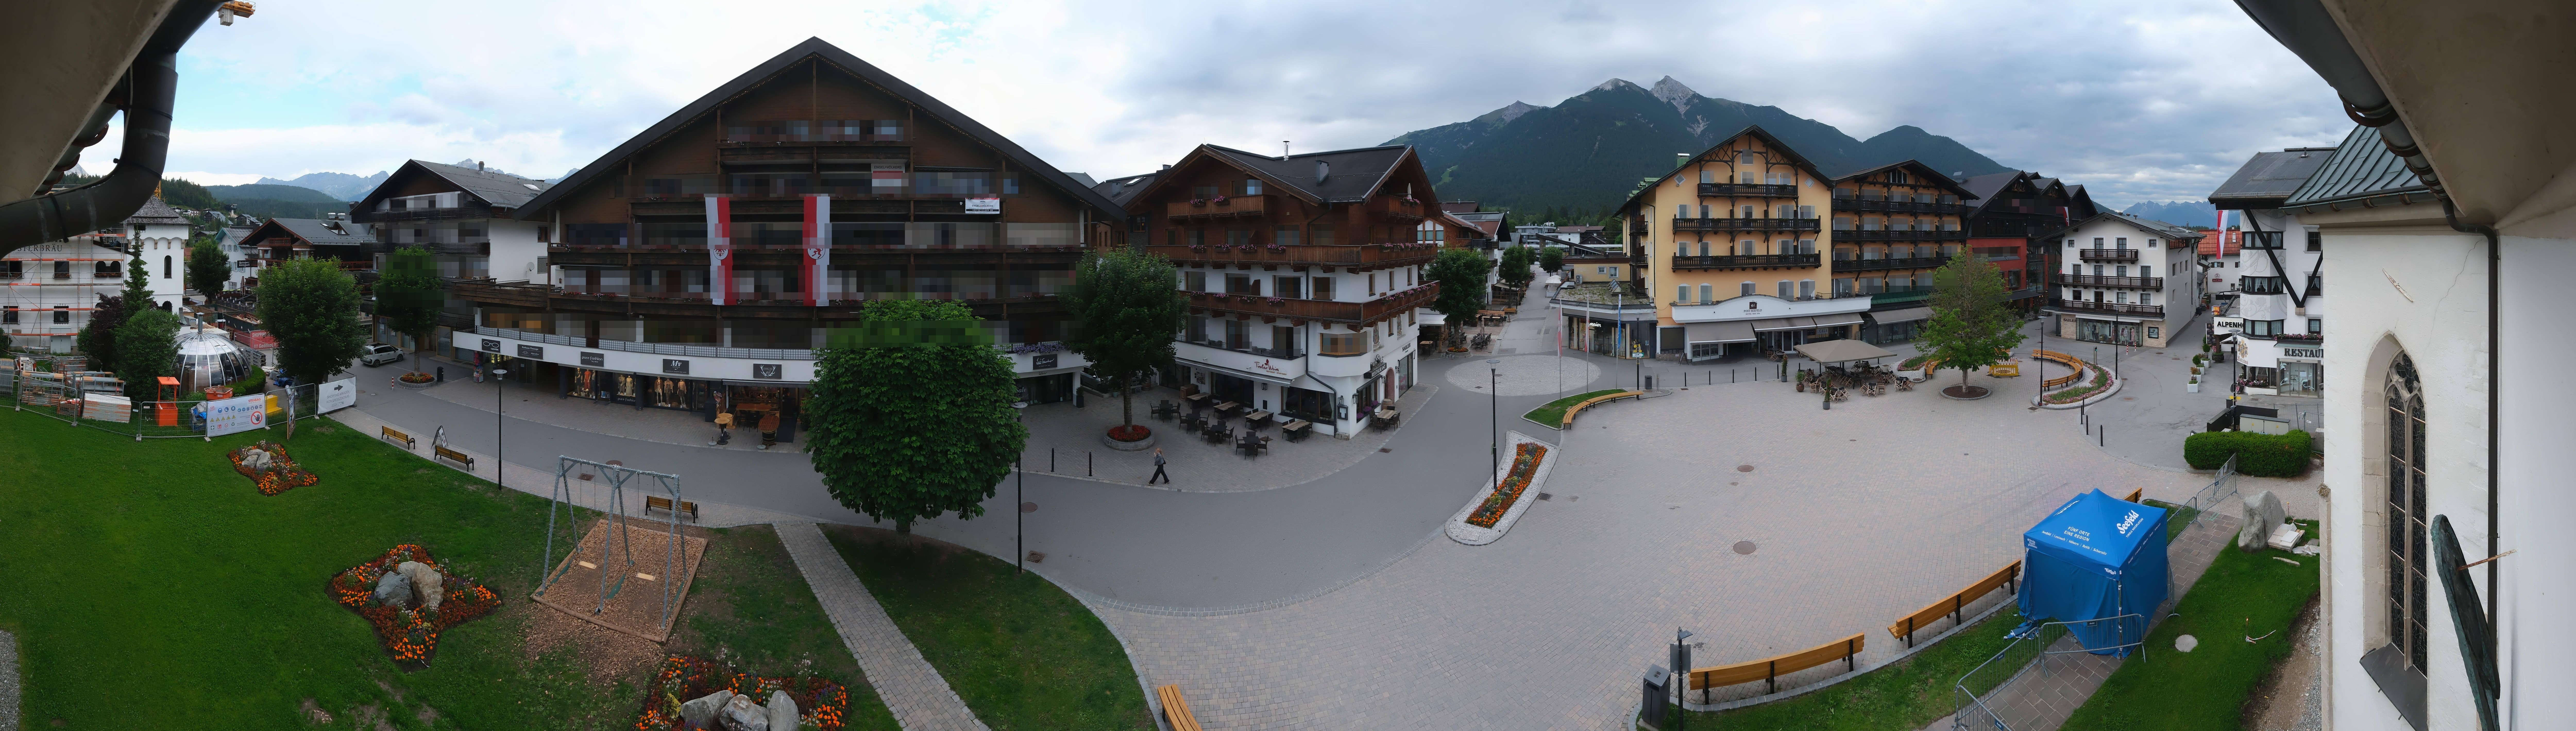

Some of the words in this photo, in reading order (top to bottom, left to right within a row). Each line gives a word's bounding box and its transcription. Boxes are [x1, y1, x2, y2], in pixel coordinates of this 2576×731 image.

[1402, 343, 1411, 352] SAILER
[671, 360, 682, 370] My
[1372, 364, 1386, 377] RESTAURANT
[326, 395, 349, 403] KONGRESSZENTRUM
[2117, 510, 2139, 534] Seefeld
[2132, 518, 2144, 531] HOCHPLATEAU
